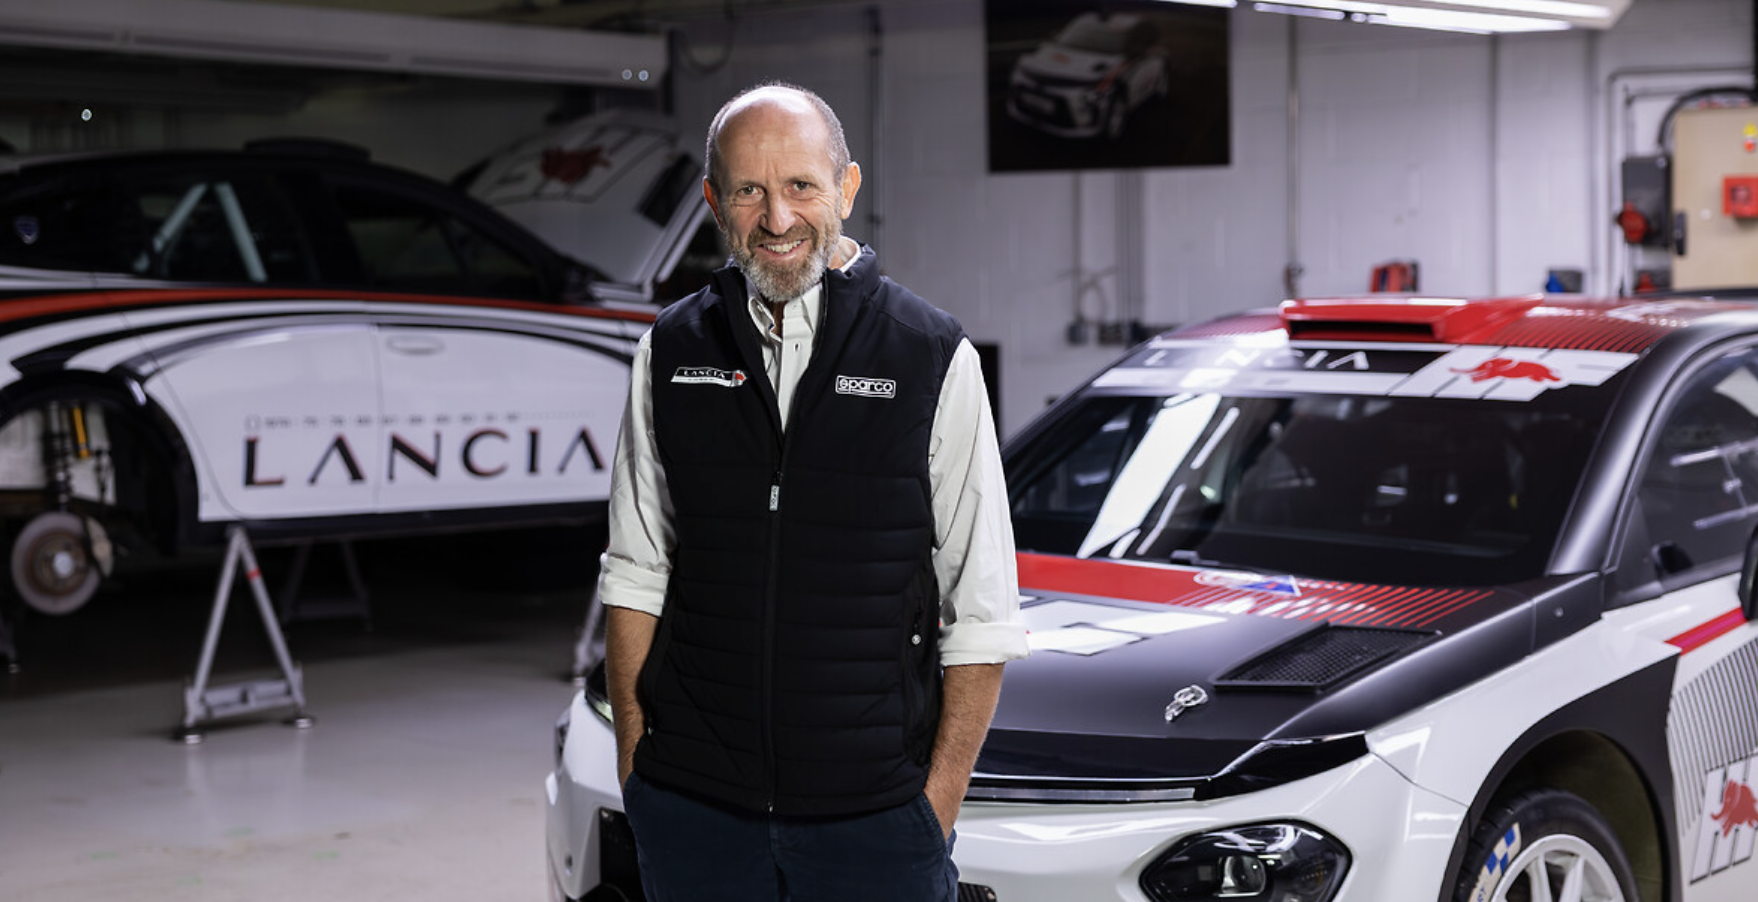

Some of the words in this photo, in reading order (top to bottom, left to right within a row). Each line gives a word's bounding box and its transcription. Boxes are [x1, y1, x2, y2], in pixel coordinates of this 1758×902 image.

[1144, 349, 1369, 370] LNCIA
[683, 369, 726, 380] LANCIA
[838, 378, 894, 395] sparco
[243, 427, 607, 487] LANCIA
